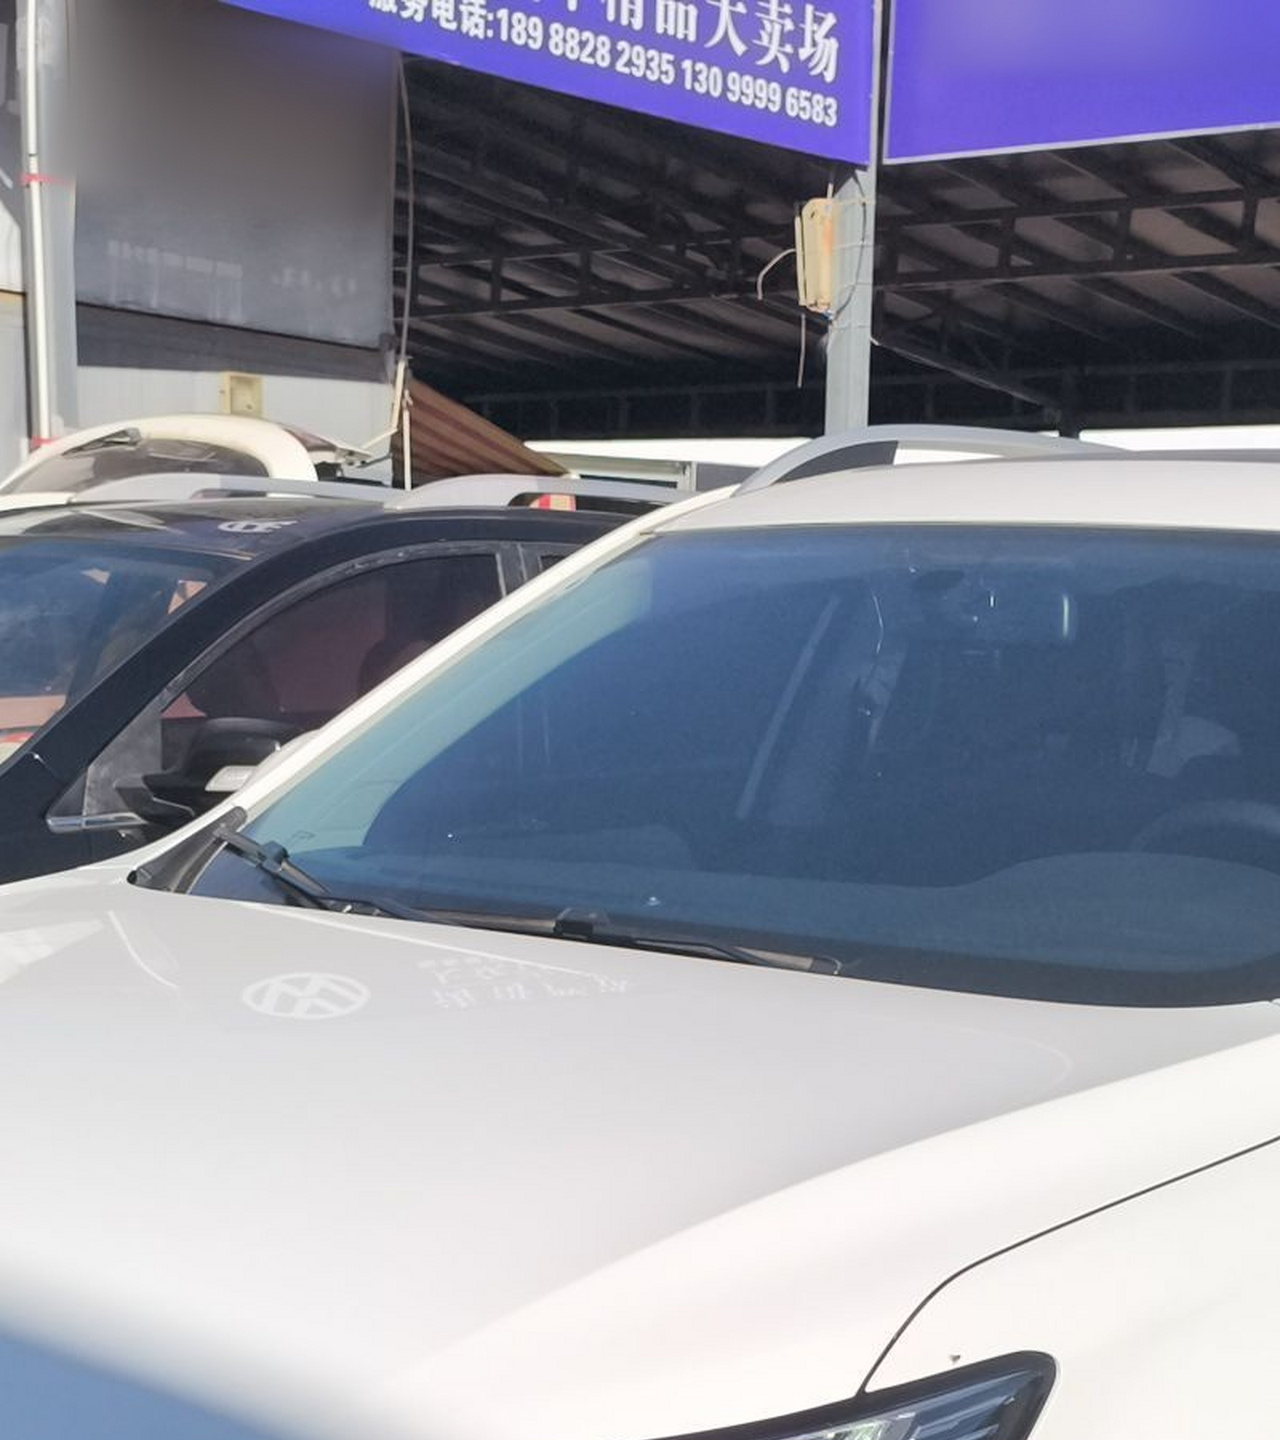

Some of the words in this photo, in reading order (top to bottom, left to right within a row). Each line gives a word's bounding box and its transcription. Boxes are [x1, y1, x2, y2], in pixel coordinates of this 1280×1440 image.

[548, 22, 611, 68] 8828
[615, 40, 675, 85] 2935
[680, 58, 723, 98] 130
[726, 71, 781, 113] 9999
[785, 86, 838, 128] 6583
[566, 0, 839, 84] 品大卖场
